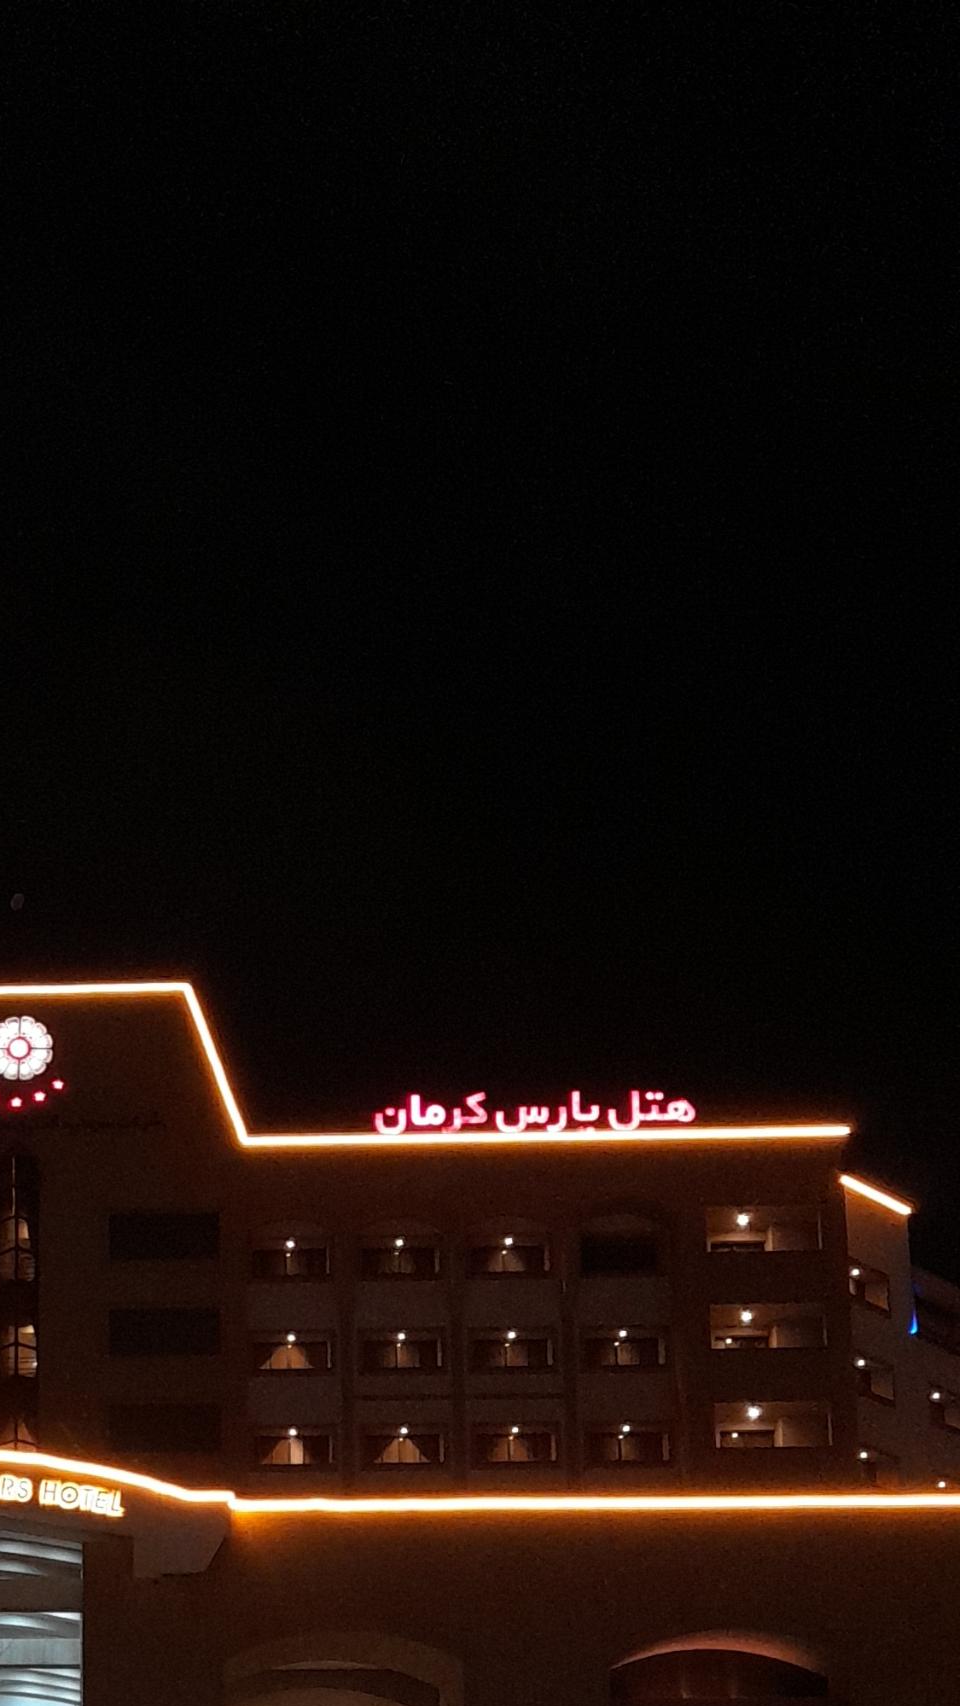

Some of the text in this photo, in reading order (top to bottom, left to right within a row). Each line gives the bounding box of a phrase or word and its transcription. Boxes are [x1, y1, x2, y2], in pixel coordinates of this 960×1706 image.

[374, 1090, 696, 1134] هتل پارس کرمان
[40, 1480, 123, 1516] HOTEL
